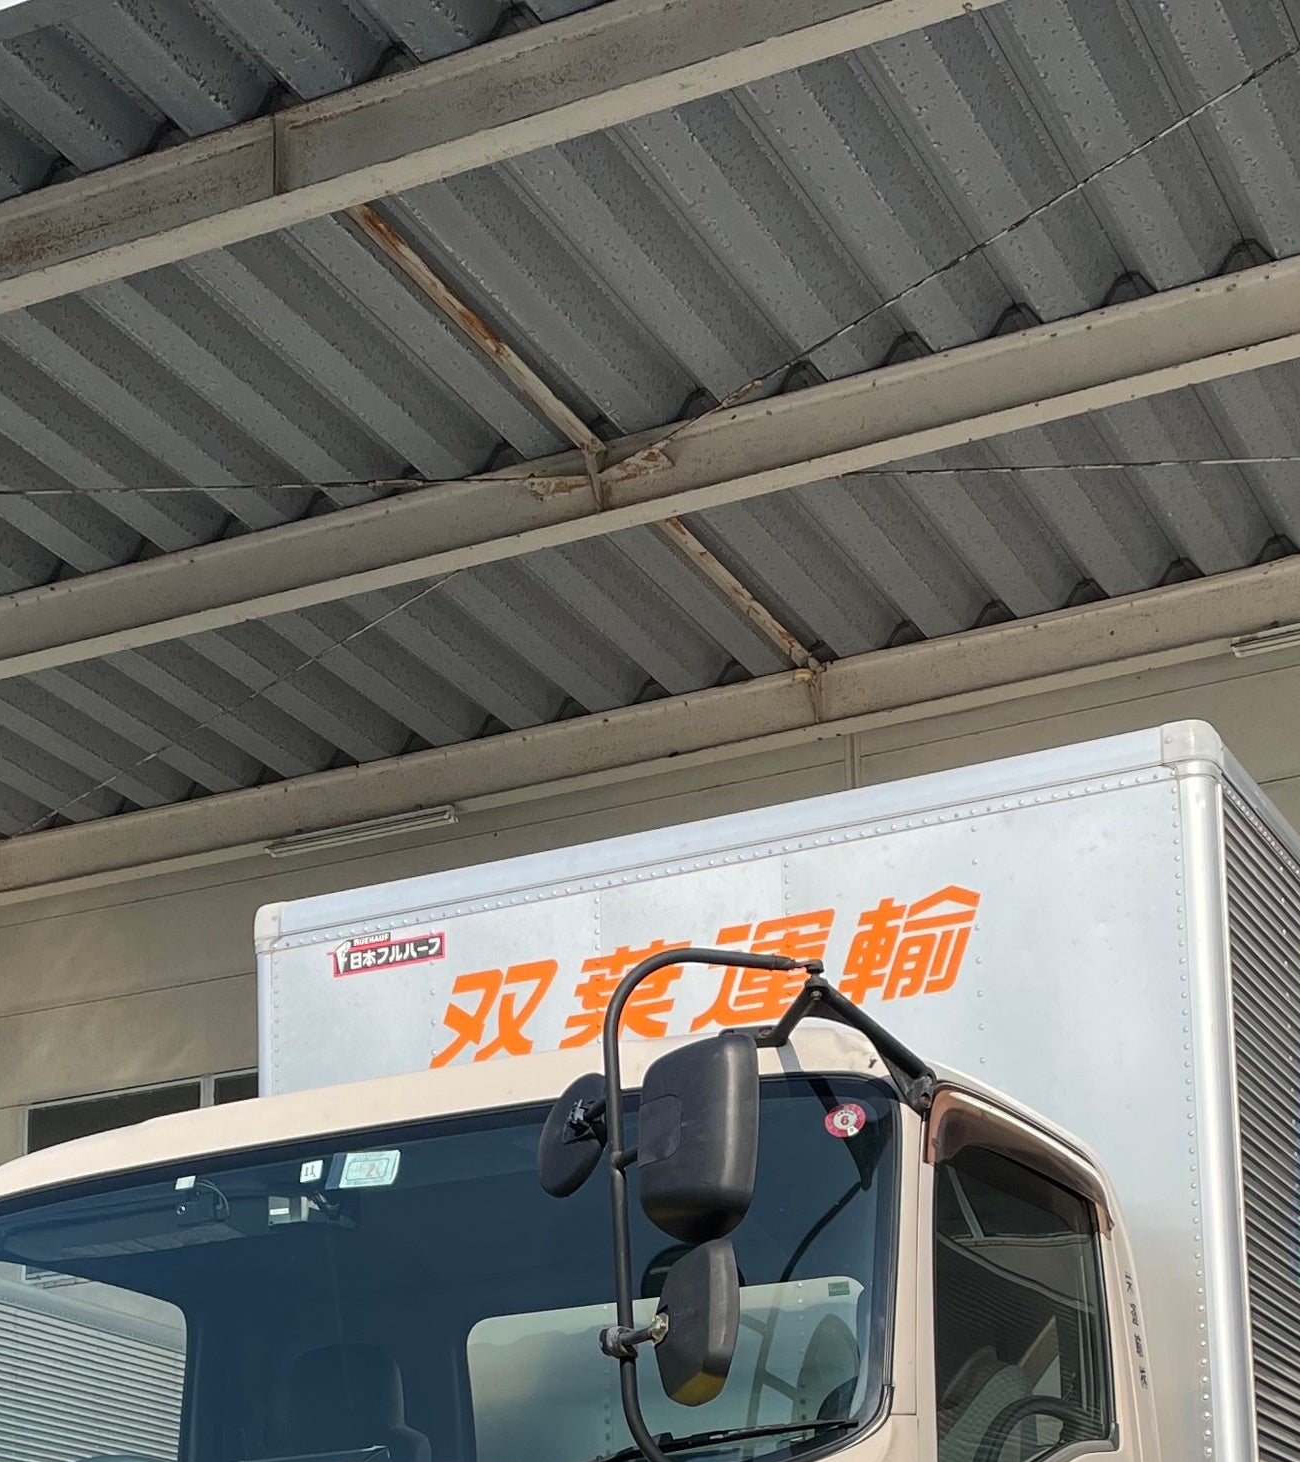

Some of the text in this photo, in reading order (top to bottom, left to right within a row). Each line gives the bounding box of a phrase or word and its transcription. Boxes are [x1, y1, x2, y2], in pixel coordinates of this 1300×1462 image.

[350, 937, 441, 969] 日本フルハーフ
[431, 885, 980, 1068] 双葉運輸
